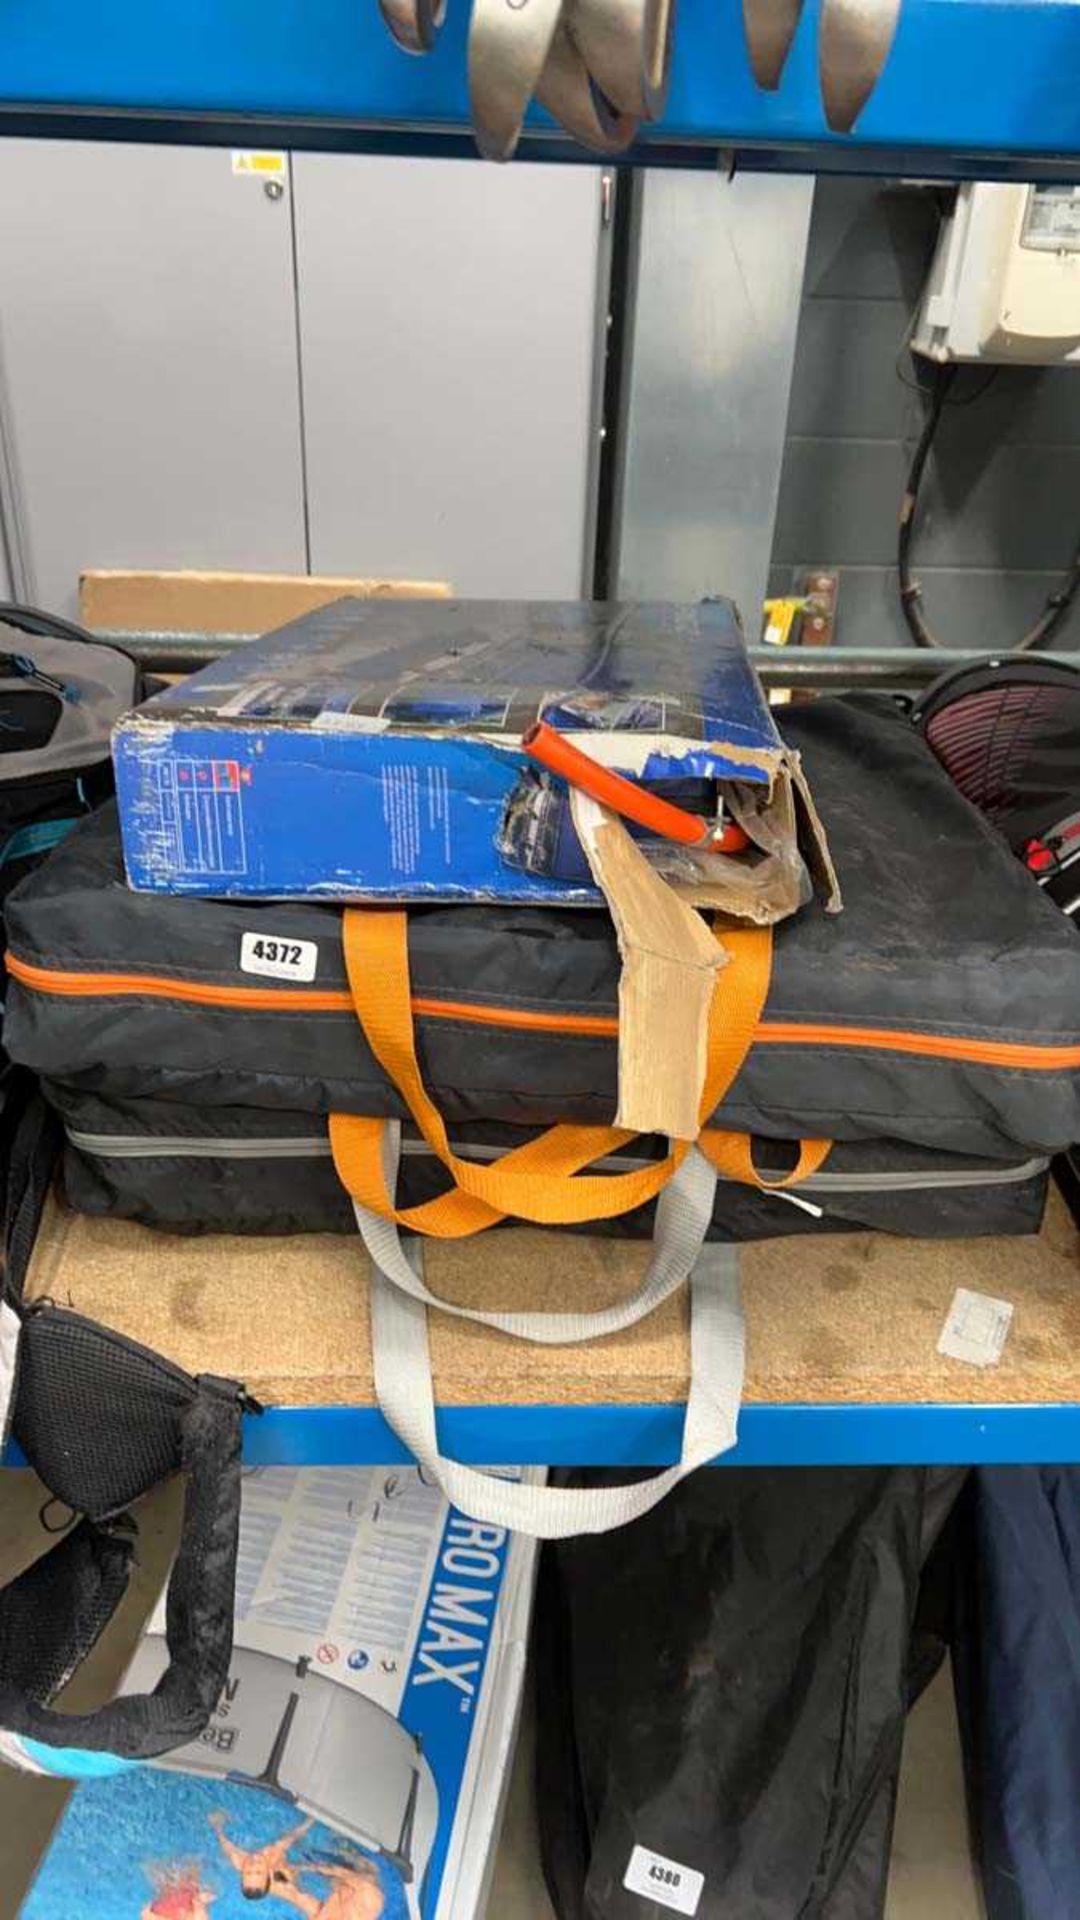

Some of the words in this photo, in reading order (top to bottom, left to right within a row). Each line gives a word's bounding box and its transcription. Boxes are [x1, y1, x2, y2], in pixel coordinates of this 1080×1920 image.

[253, 940, 302, 965] 4372
[442, 1519, 506, 1578] RO
[412, 1582, 495, 1695] MAX
